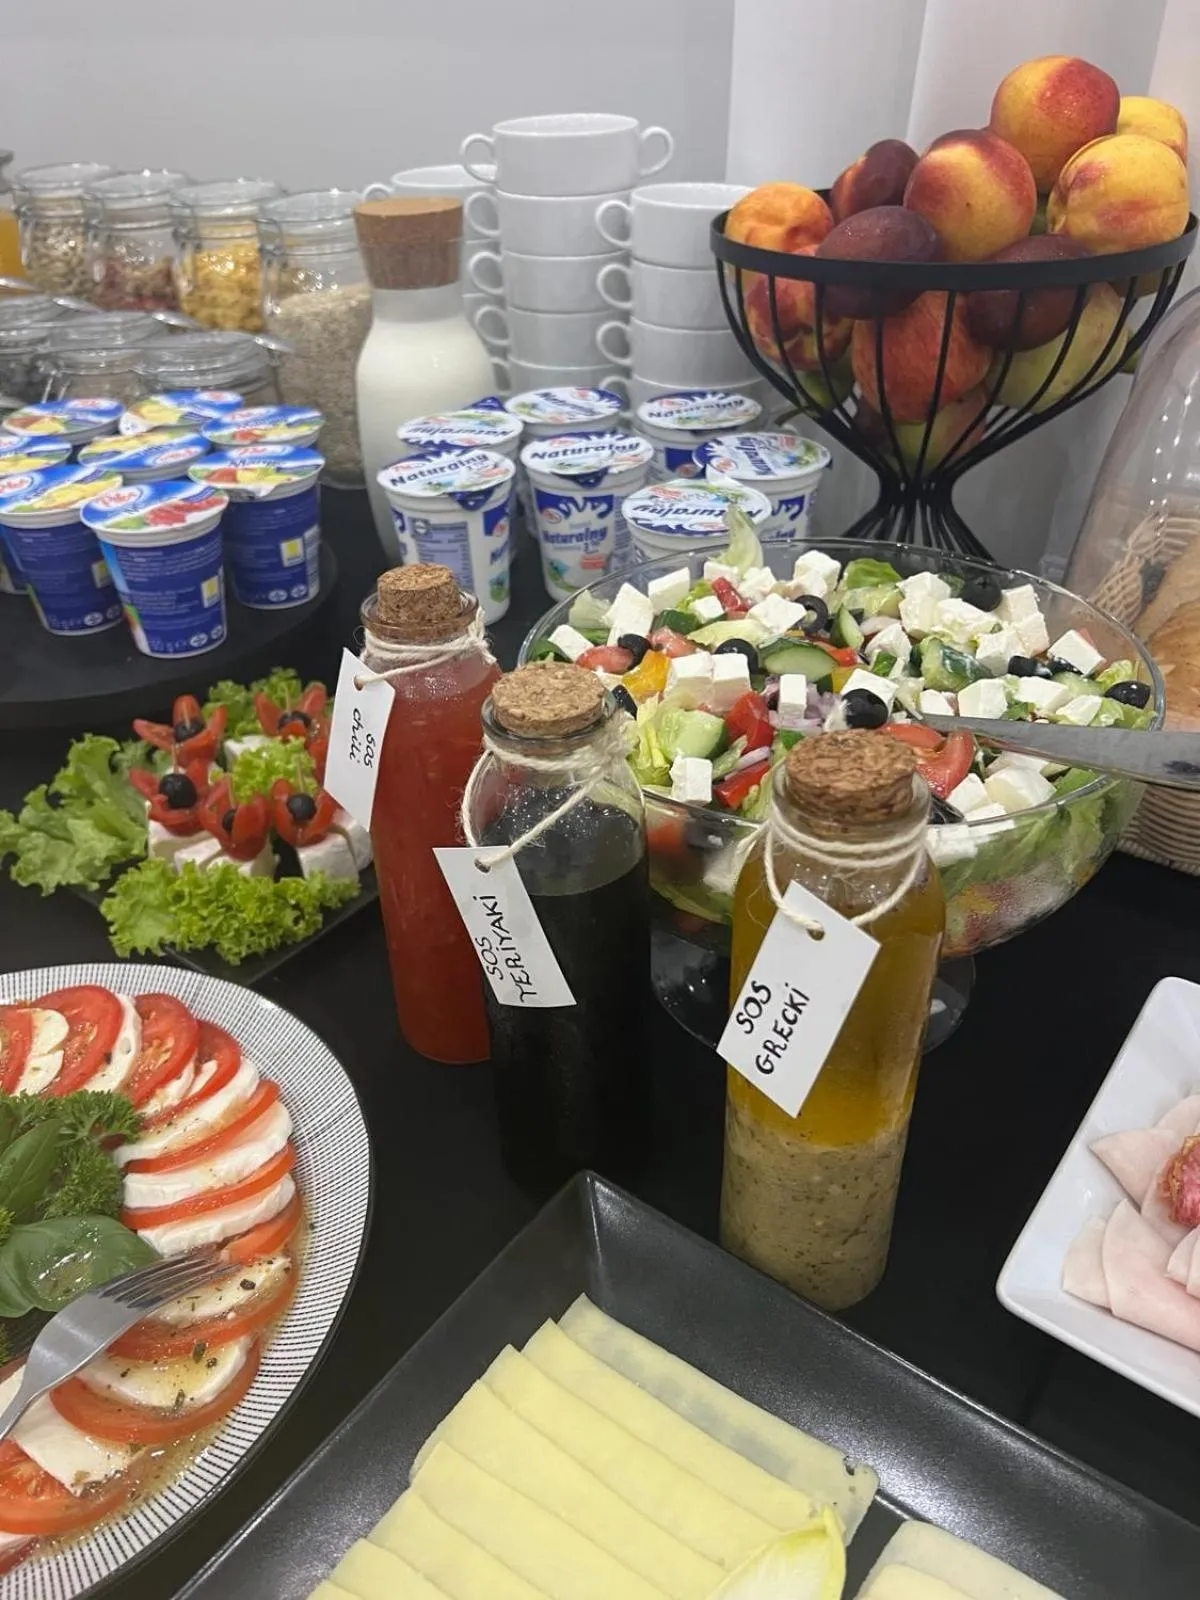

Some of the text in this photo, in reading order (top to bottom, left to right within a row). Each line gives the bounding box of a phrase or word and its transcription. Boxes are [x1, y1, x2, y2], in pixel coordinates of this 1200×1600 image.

[530, 442, 641, 460] Naturalny
[389, 454, 489, 487] Naturalny
[632, 504, 763, 519] Nturalny
[475, 936, 504, 980] SOS
[735, 980, 772, 1034] SOS
